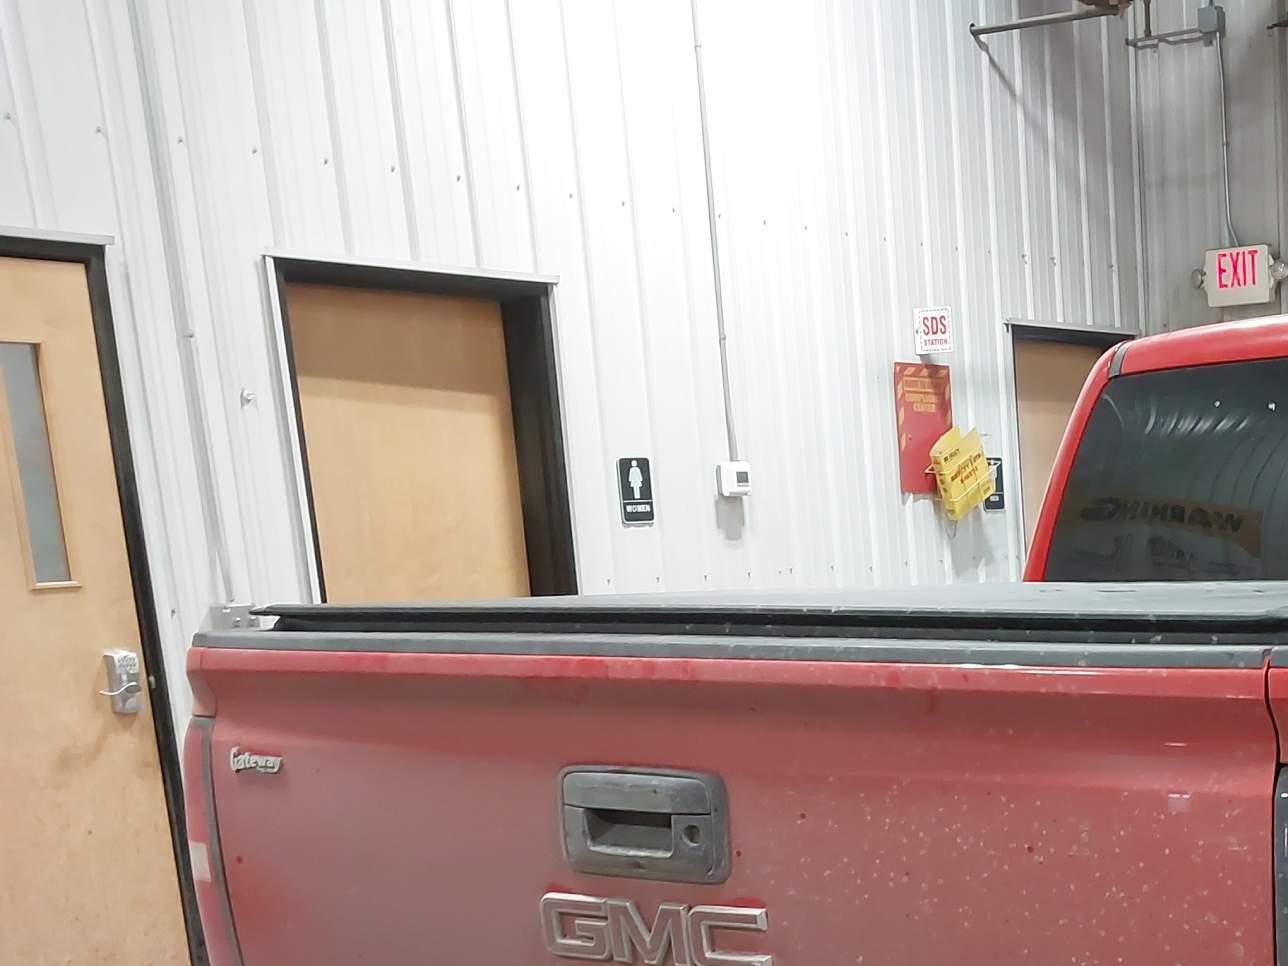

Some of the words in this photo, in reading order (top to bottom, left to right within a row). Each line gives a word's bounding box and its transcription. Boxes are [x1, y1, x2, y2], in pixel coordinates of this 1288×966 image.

[1217, 249, 1258, 289] EXIT
[922, 315, 947, 336] SDS
[923, 338, 948, 346] STATION
[626, 504, 651, 513] WOMEN
